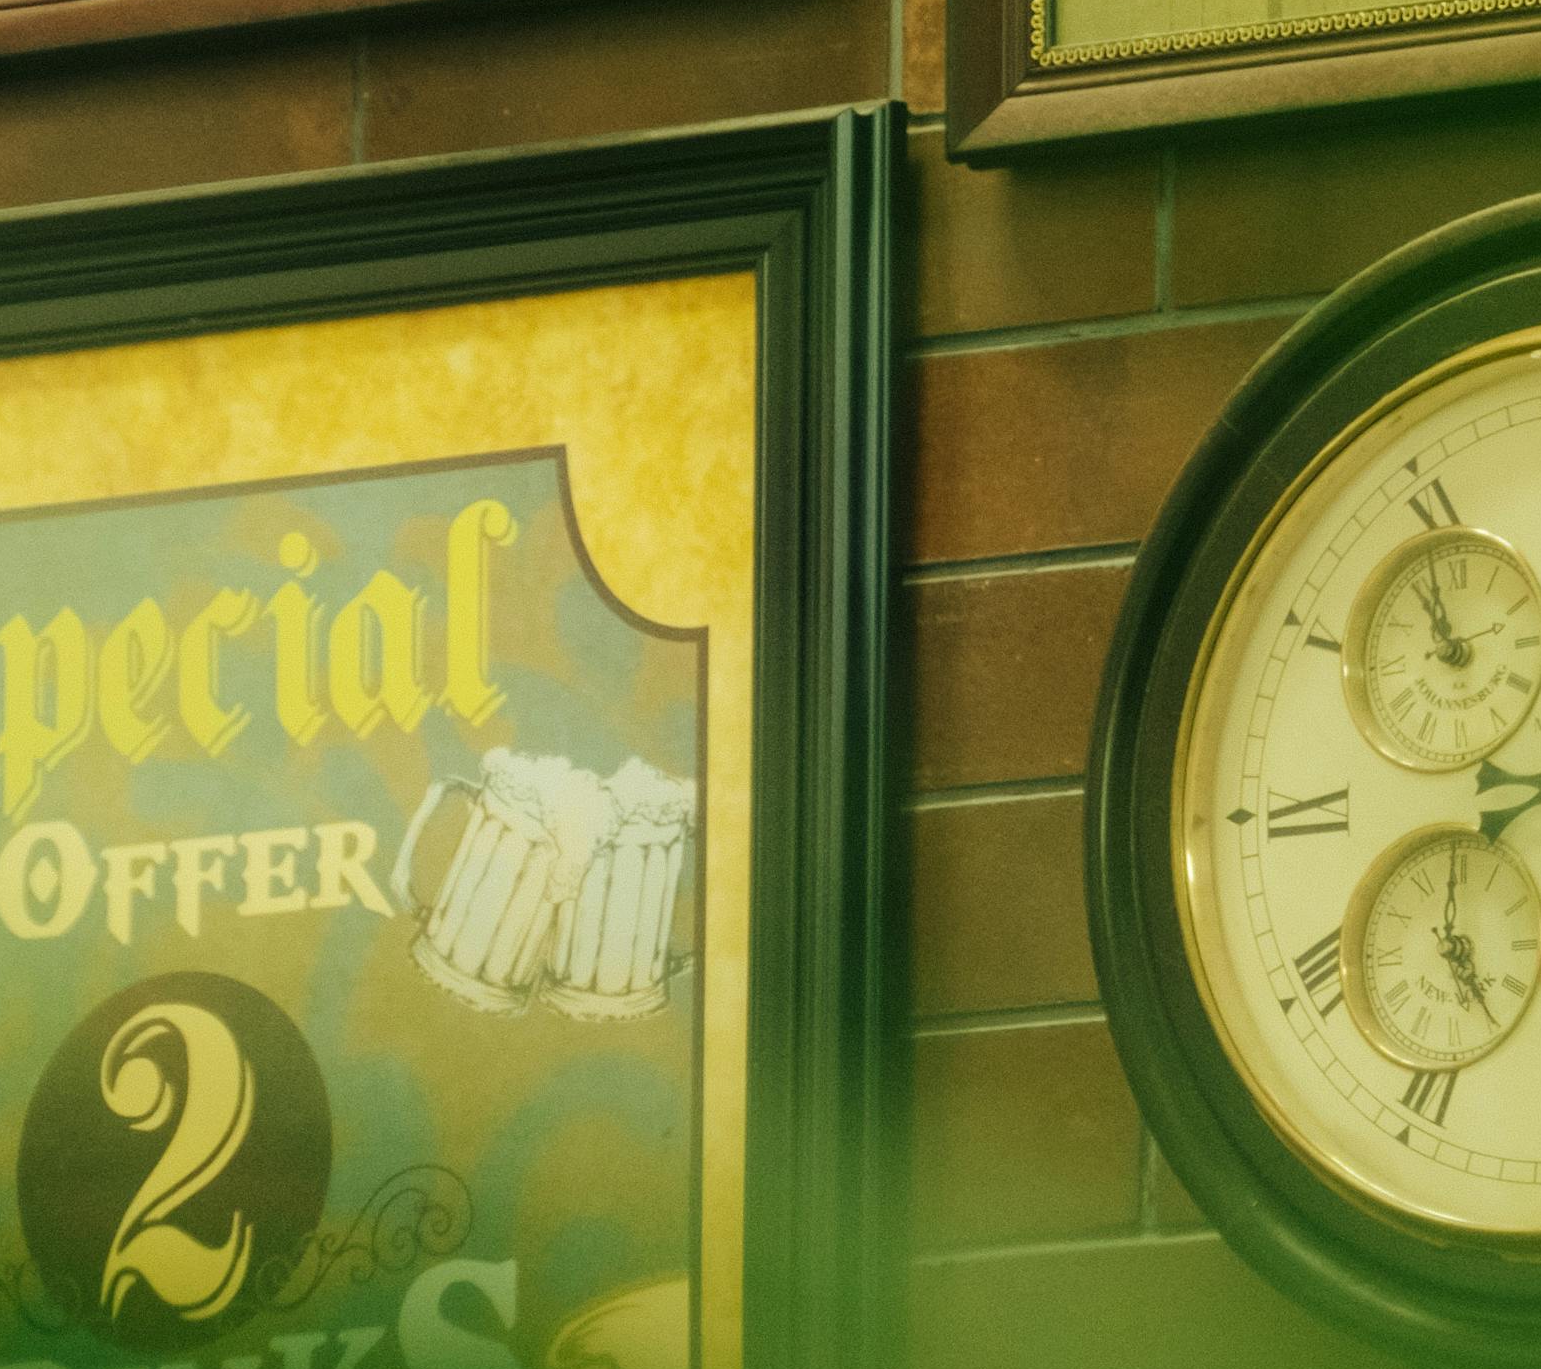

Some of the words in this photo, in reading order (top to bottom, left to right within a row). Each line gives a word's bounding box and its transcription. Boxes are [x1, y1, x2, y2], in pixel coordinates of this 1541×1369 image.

[1415, 664, 1507, 710] JOHANNESBURG
[1414, 974, 1497, 1006] NEW-YRK
[99, 1002, 255, 1323] 2
